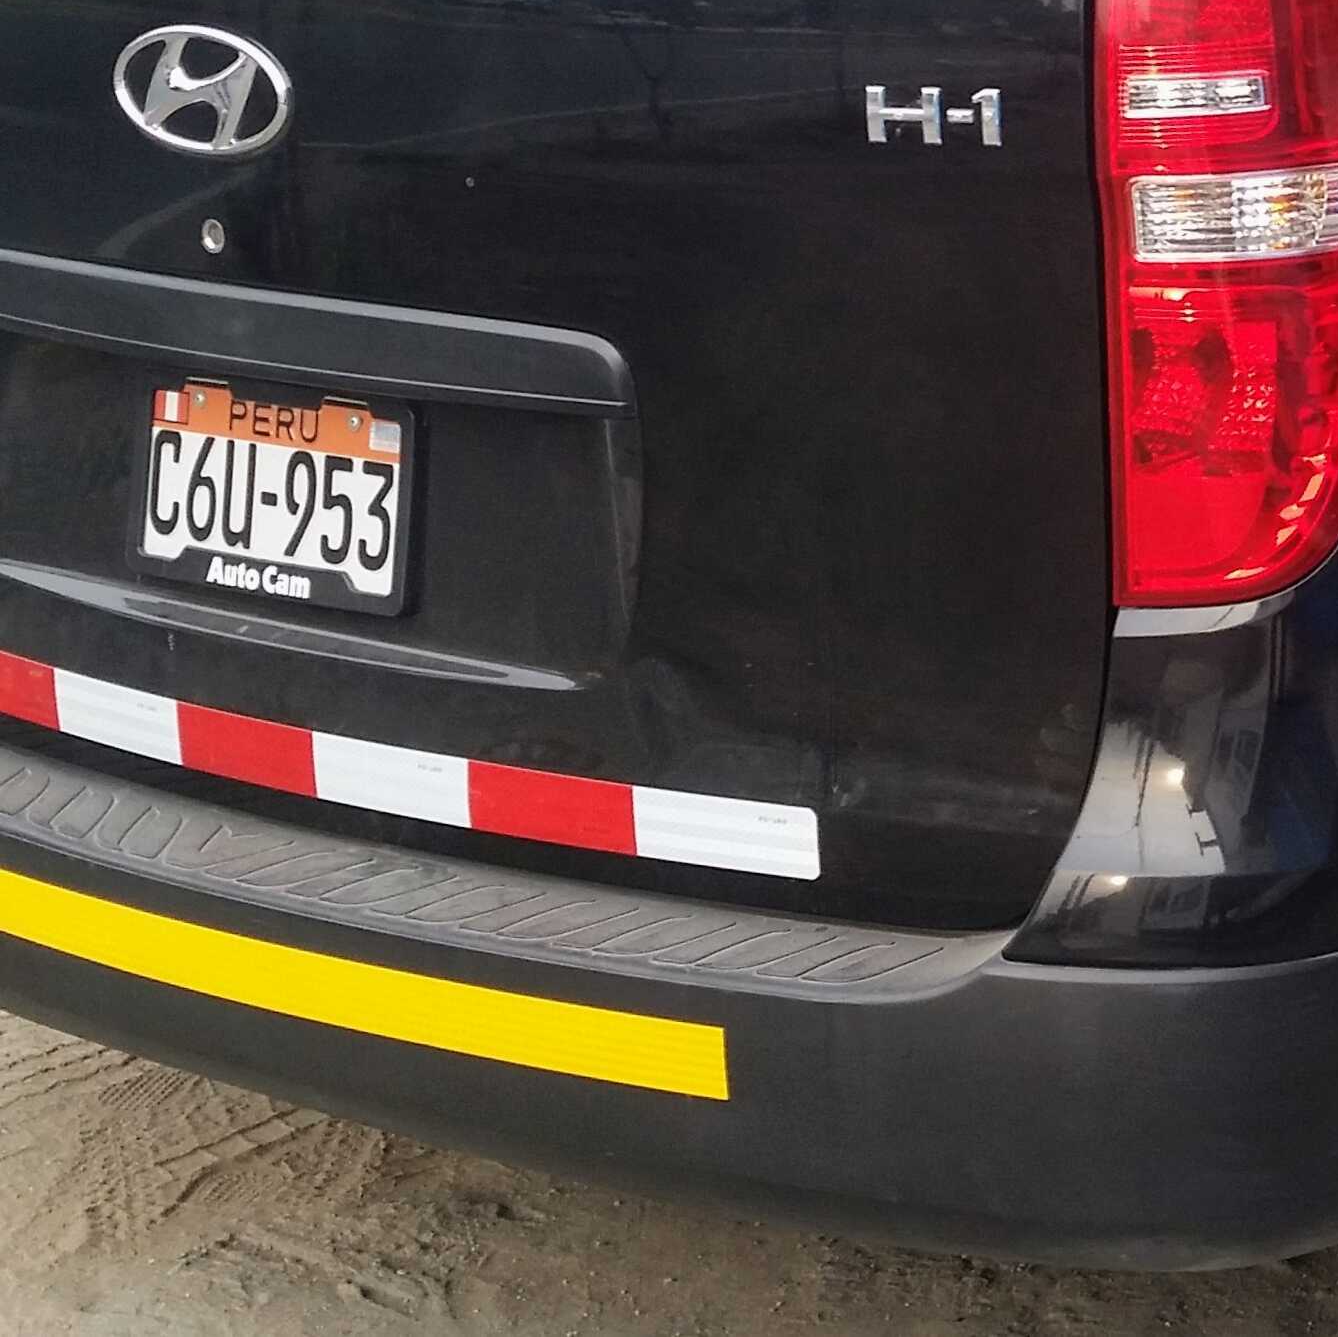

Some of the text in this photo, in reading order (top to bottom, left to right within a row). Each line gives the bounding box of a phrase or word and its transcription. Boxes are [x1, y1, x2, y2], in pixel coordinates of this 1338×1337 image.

[865, 85, 1002, 146] H-1
[228, 399, 320, 443] PERU
[150, 429, 395, 571] C6U-953
[206, 556, 311, 600] Auto Cam
